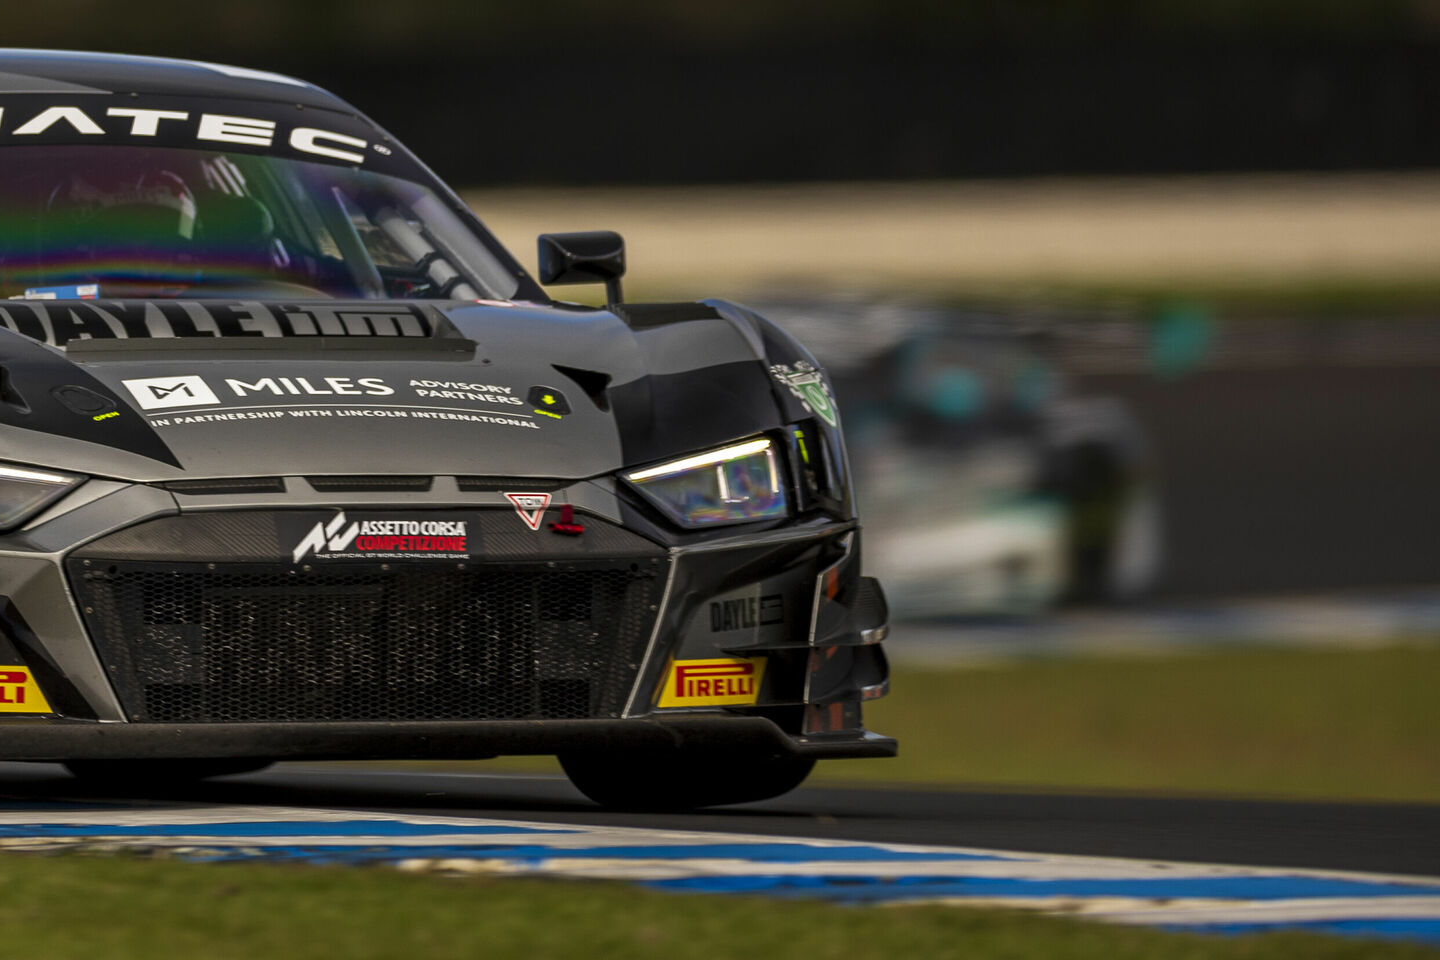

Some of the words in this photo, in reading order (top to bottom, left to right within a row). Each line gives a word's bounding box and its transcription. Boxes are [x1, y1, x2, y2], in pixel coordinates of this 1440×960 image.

[224, 377, 395, 397] MILES
[409, 379, 513, 395] ADVISORY
[415, 389, 524, 406] PARTNERS
[150, 419, 170, 428] IN
[173, 411, 285, 425] PARTNERSHIP
[289, 409, 332, 418] WITH
[336, 409, 408, 418] LINCOLN
[410, 411, 541, 429] INTERNATIONAL
[360, 521, 420, 536] ASSETTO
[421, 521, 466, 536] CORSA
[356, 535, 467, 552] COMPETIZIONE
[675, 663, 755, 698] PIRELLI
